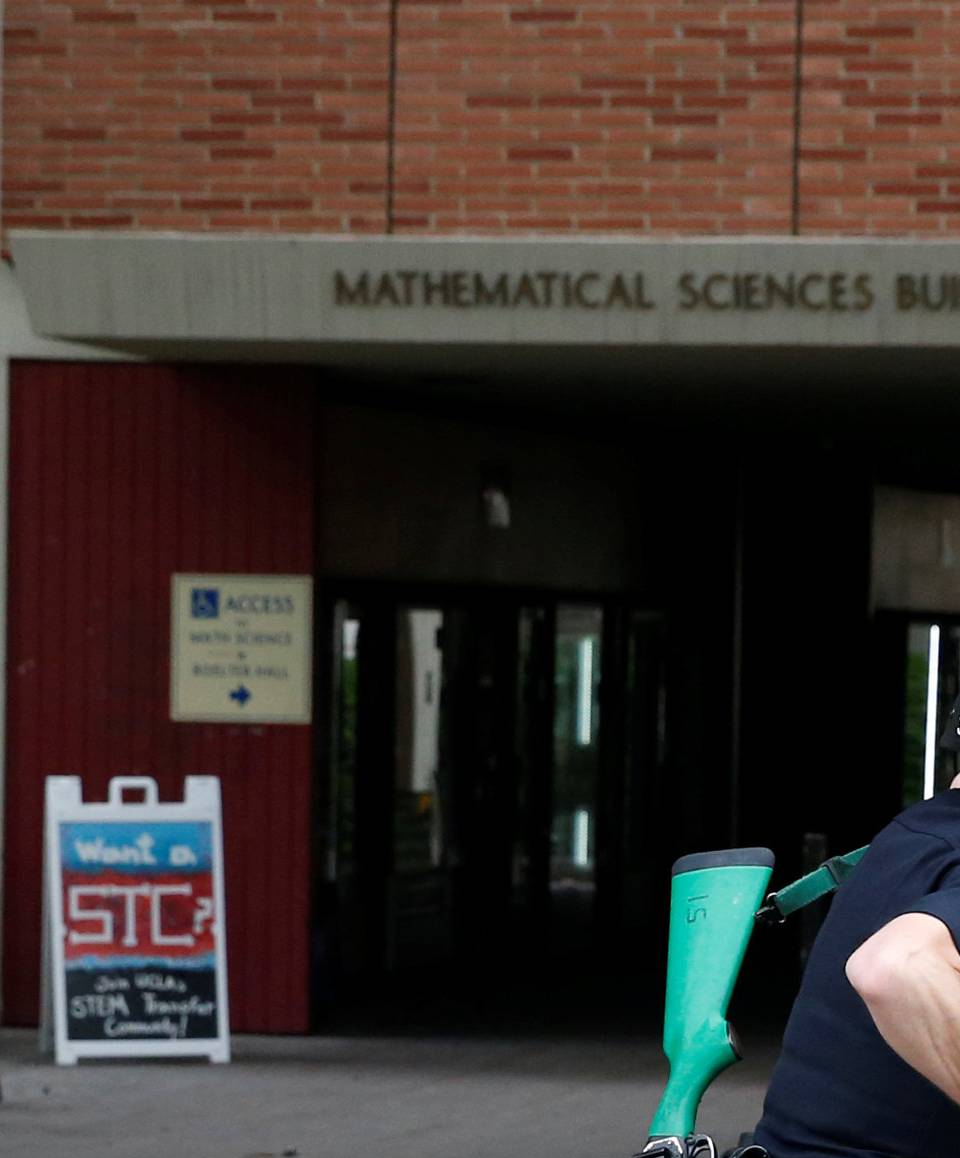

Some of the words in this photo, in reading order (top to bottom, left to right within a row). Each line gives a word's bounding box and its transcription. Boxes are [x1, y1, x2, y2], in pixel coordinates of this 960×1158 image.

[334, 269, 656, 310] MATHEMATICAL
[678, 271, 875, 312] SCIENCES
[226, 595, 295, 614] ACCESS
[74, 832, 157, 866] Want
[169, 844, 198, 867] a
[68, 882, 214, 947] STC?
[70, 992, 131, 1019] STEM
